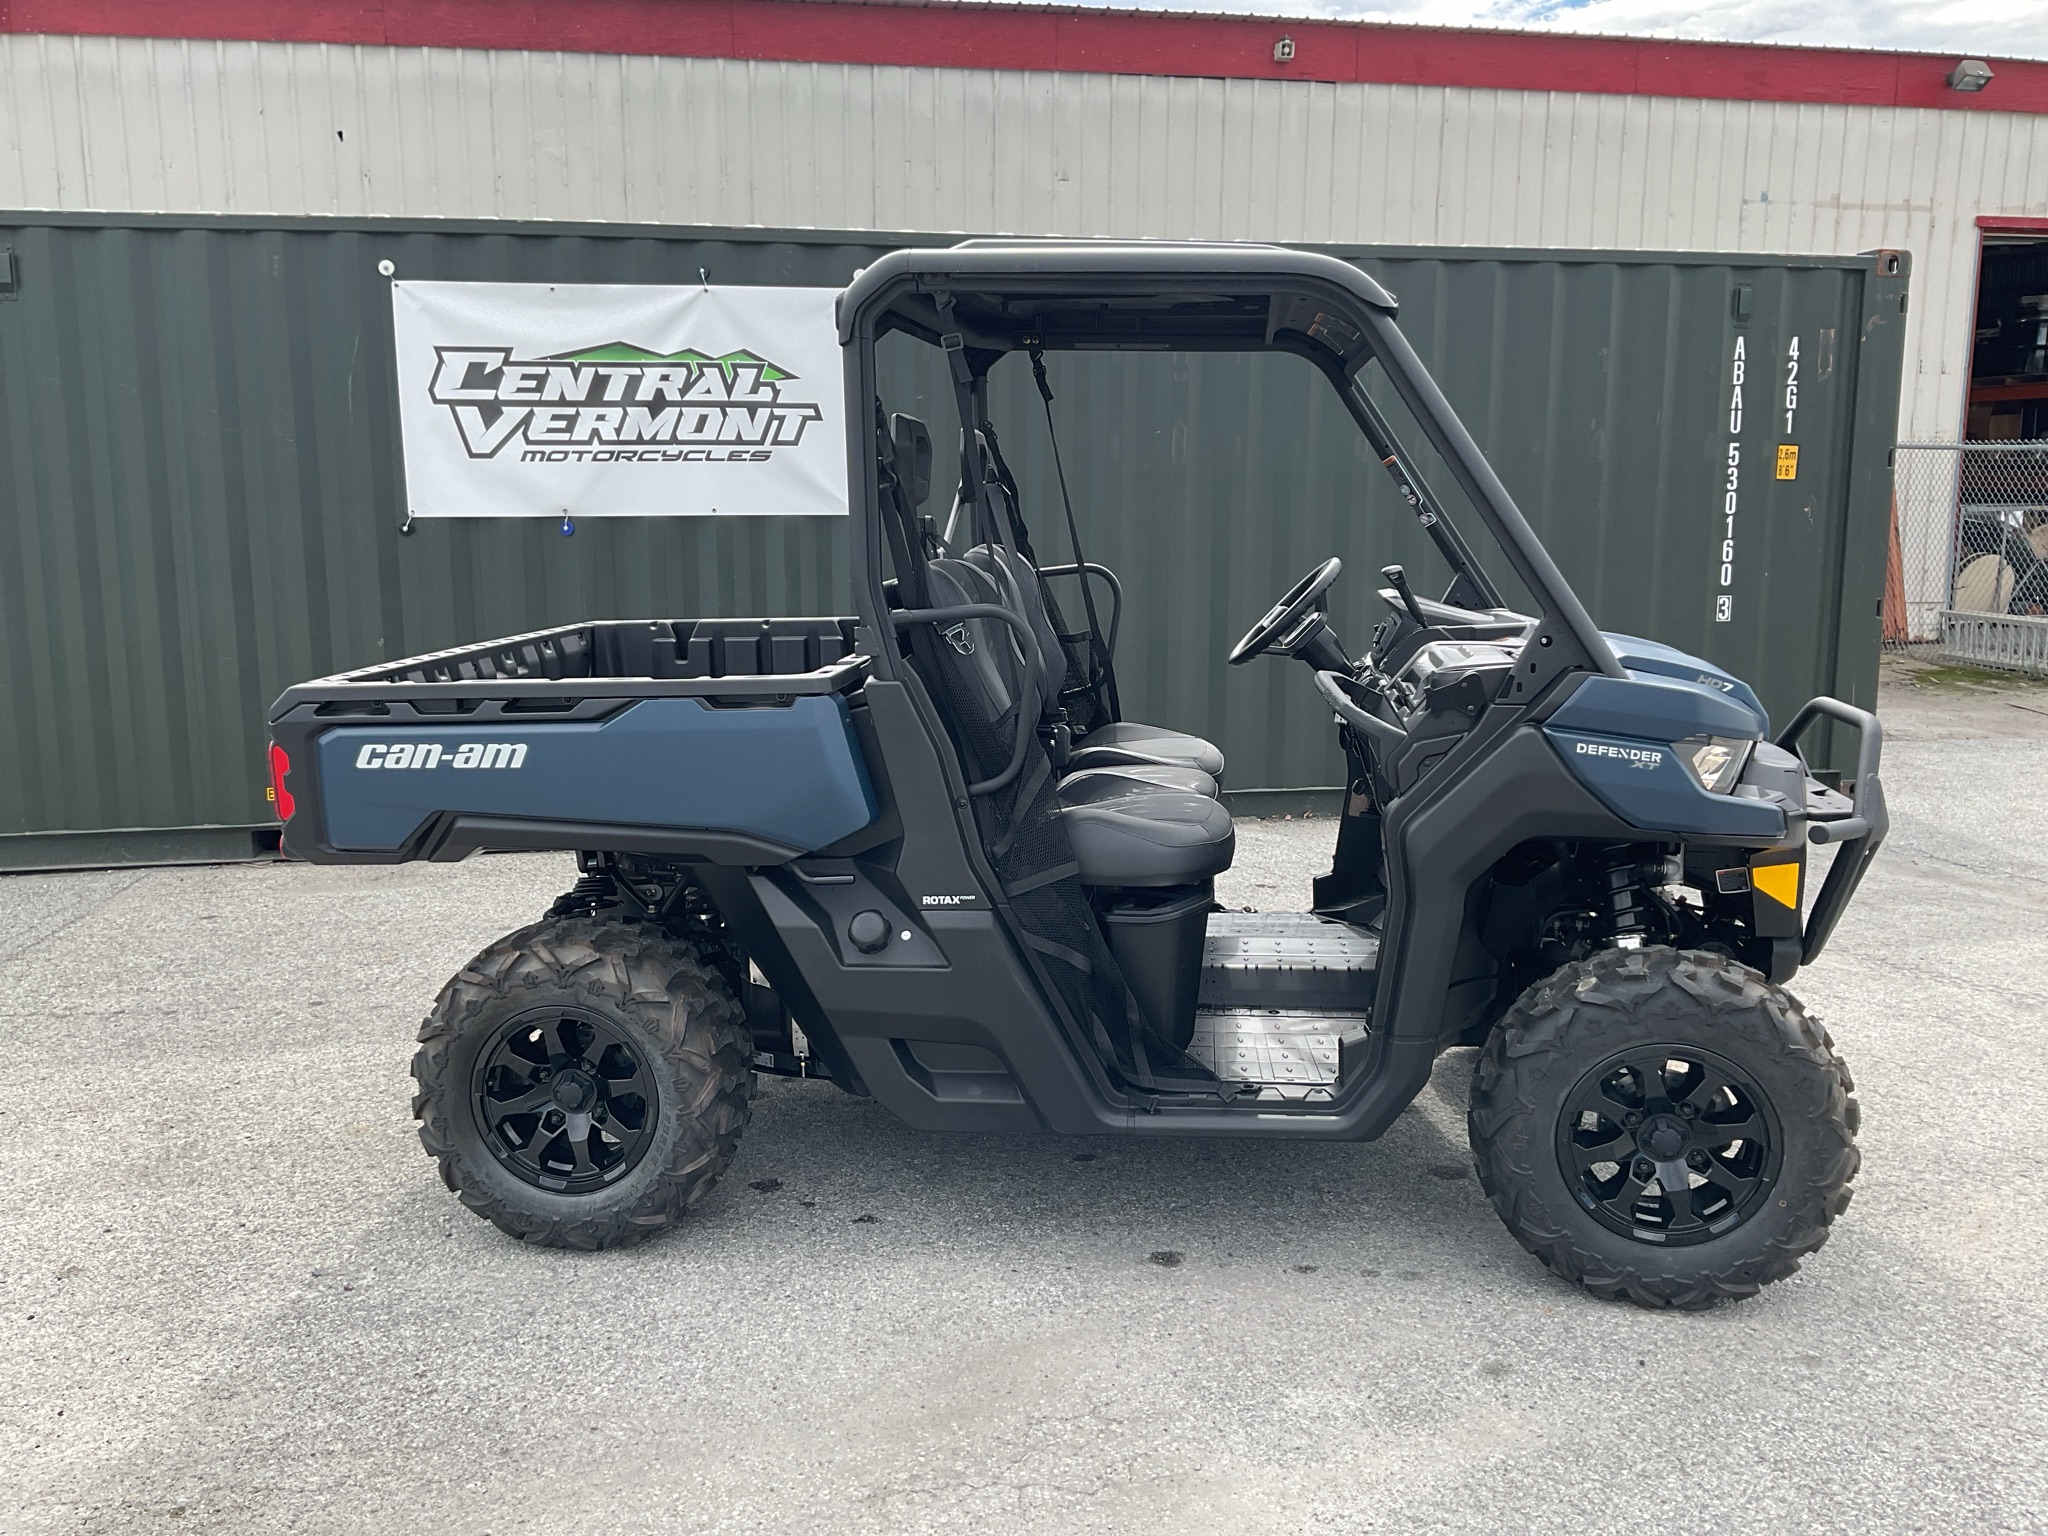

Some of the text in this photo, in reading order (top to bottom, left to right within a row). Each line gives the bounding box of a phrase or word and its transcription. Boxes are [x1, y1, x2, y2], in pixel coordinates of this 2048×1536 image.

[430, 347, 784, 402] CENTRAL
[1785, 336, 1799, 434] 42G1
[452, 404, 822, 458] VERMONT
[520, 449, 773, 463] MOTORCYCLES
[1717, 336, 1745, 620] ABAU 530160 3
[1696, 674, 1734, 692] HD7
[356, 743, 528, 768] can-am
[1576, 742, 1662, 763] DEFENDER
[1629, 760, 1660, 771] XT
[922, 895, 960, 905] ROTAX
